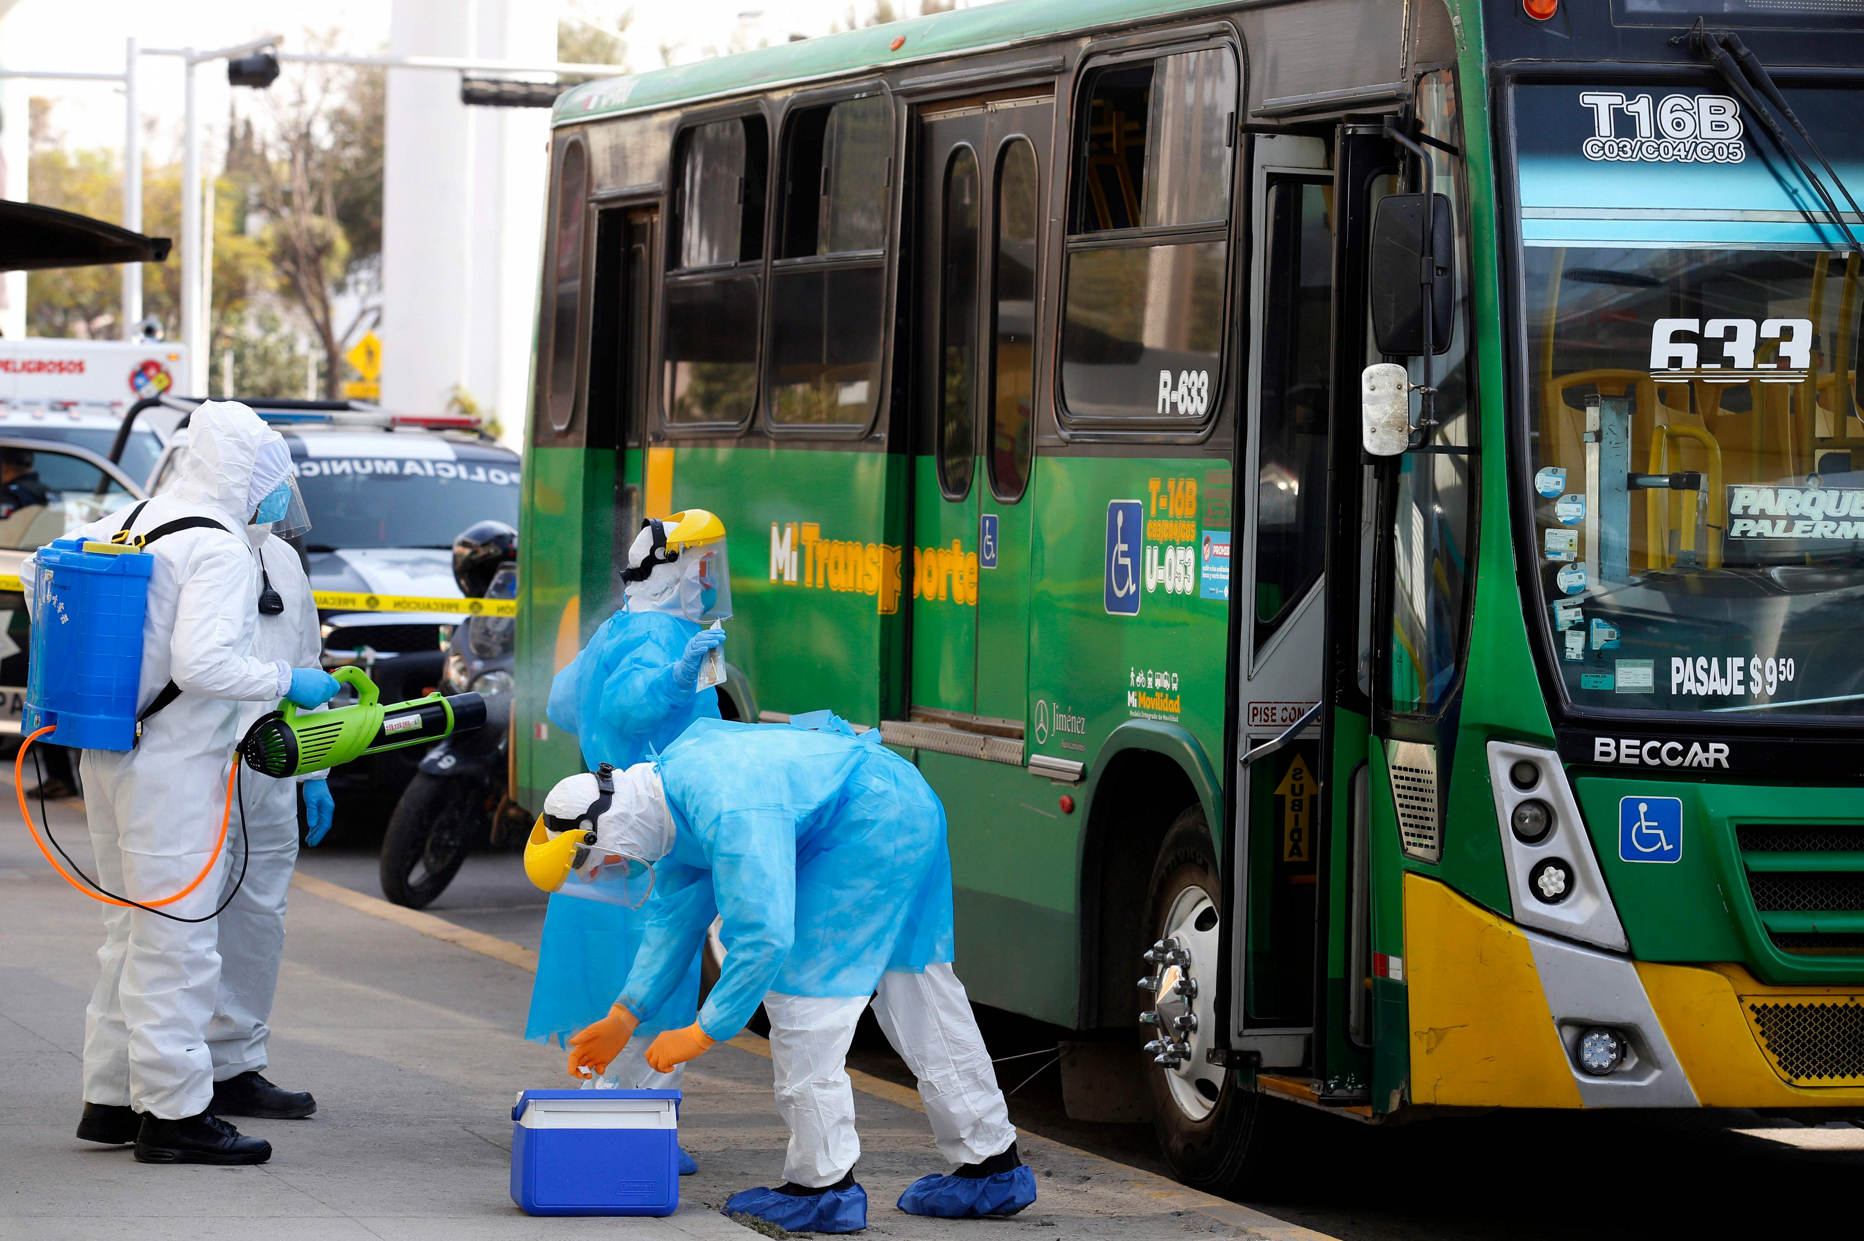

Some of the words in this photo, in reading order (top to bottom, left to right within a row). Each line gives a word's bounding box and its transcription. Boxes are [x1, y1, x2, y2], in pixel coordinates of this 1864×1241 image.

[1580, 91, 1743, 140] T16B
[1583, 138, 1745, 163] C03/C04/C05
[1650, 318, 1813, 370] 633
[1157, 369, 1209, 416] R-633
[1148, 477, 1198, 518] T-16B
[770, 521, 799, 586] Mi
[801, 521, 979, 615] Transporte
[1145, 545, 1196, 595] U-053
[1671, 656, 1745, 695] PASAJE
[1051, 702, 1086, 737] Jiménez
[1127, 690, 1138, 708] Mi
[1138, 691, 1181, 714] Movilidad
[1252, 706, 1277, 723] PISE
[1281, 706, 1305, 723] CON
[1594, 737, 1730, 769] BECCAR
